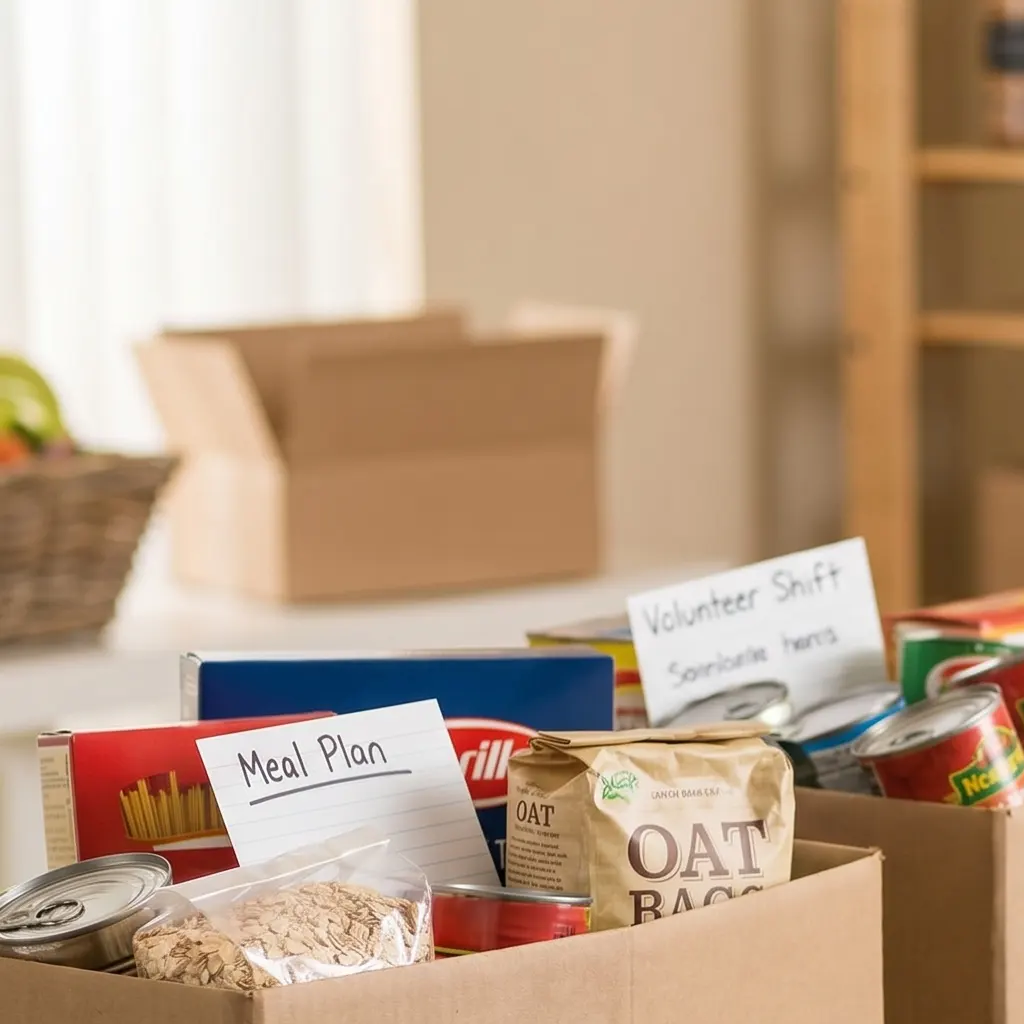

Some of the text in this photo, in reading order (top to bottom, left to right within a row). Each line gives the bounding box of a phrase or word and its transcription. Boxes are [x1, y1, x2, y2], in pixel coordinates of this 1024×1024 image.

[643, 561, 842, 636] Volunteer Shift
[237, 734, 387, 788] Meal Plan
[515, 799, 555, 828] OAT
[627, 819, 771, 883] OAT
